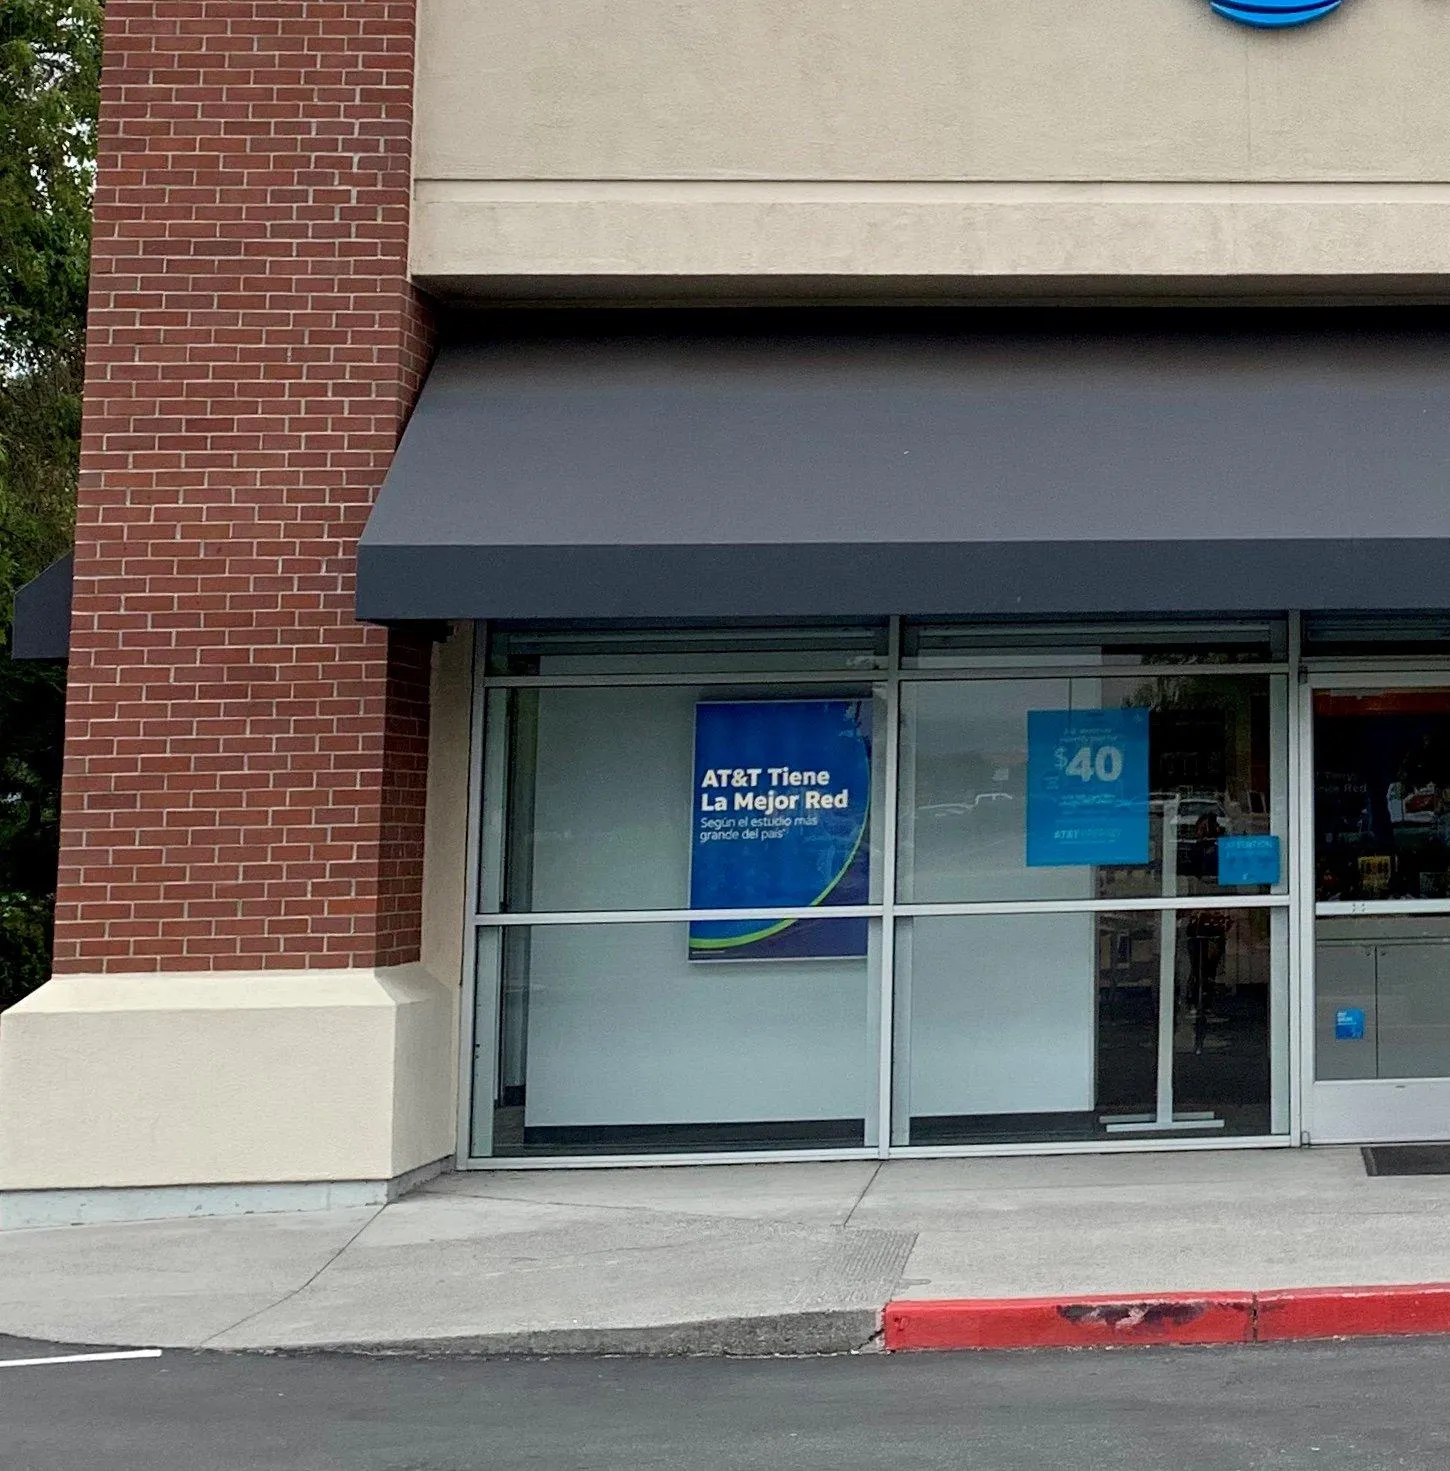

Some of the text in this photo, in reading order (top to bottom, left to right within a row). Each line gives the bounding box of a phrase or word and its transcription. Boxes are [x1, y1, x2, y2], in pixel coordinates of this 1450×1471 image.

[1054, 745, 1123, 782] $40
[701, 766, 830, 788] AT&T Tiene
[701, 789, 849, 815] La Mejor Red
[700, 815, 818, 830] Según el estudio más
[700, 829, 739, 843] grande
[742, 829, 759, 840] del
